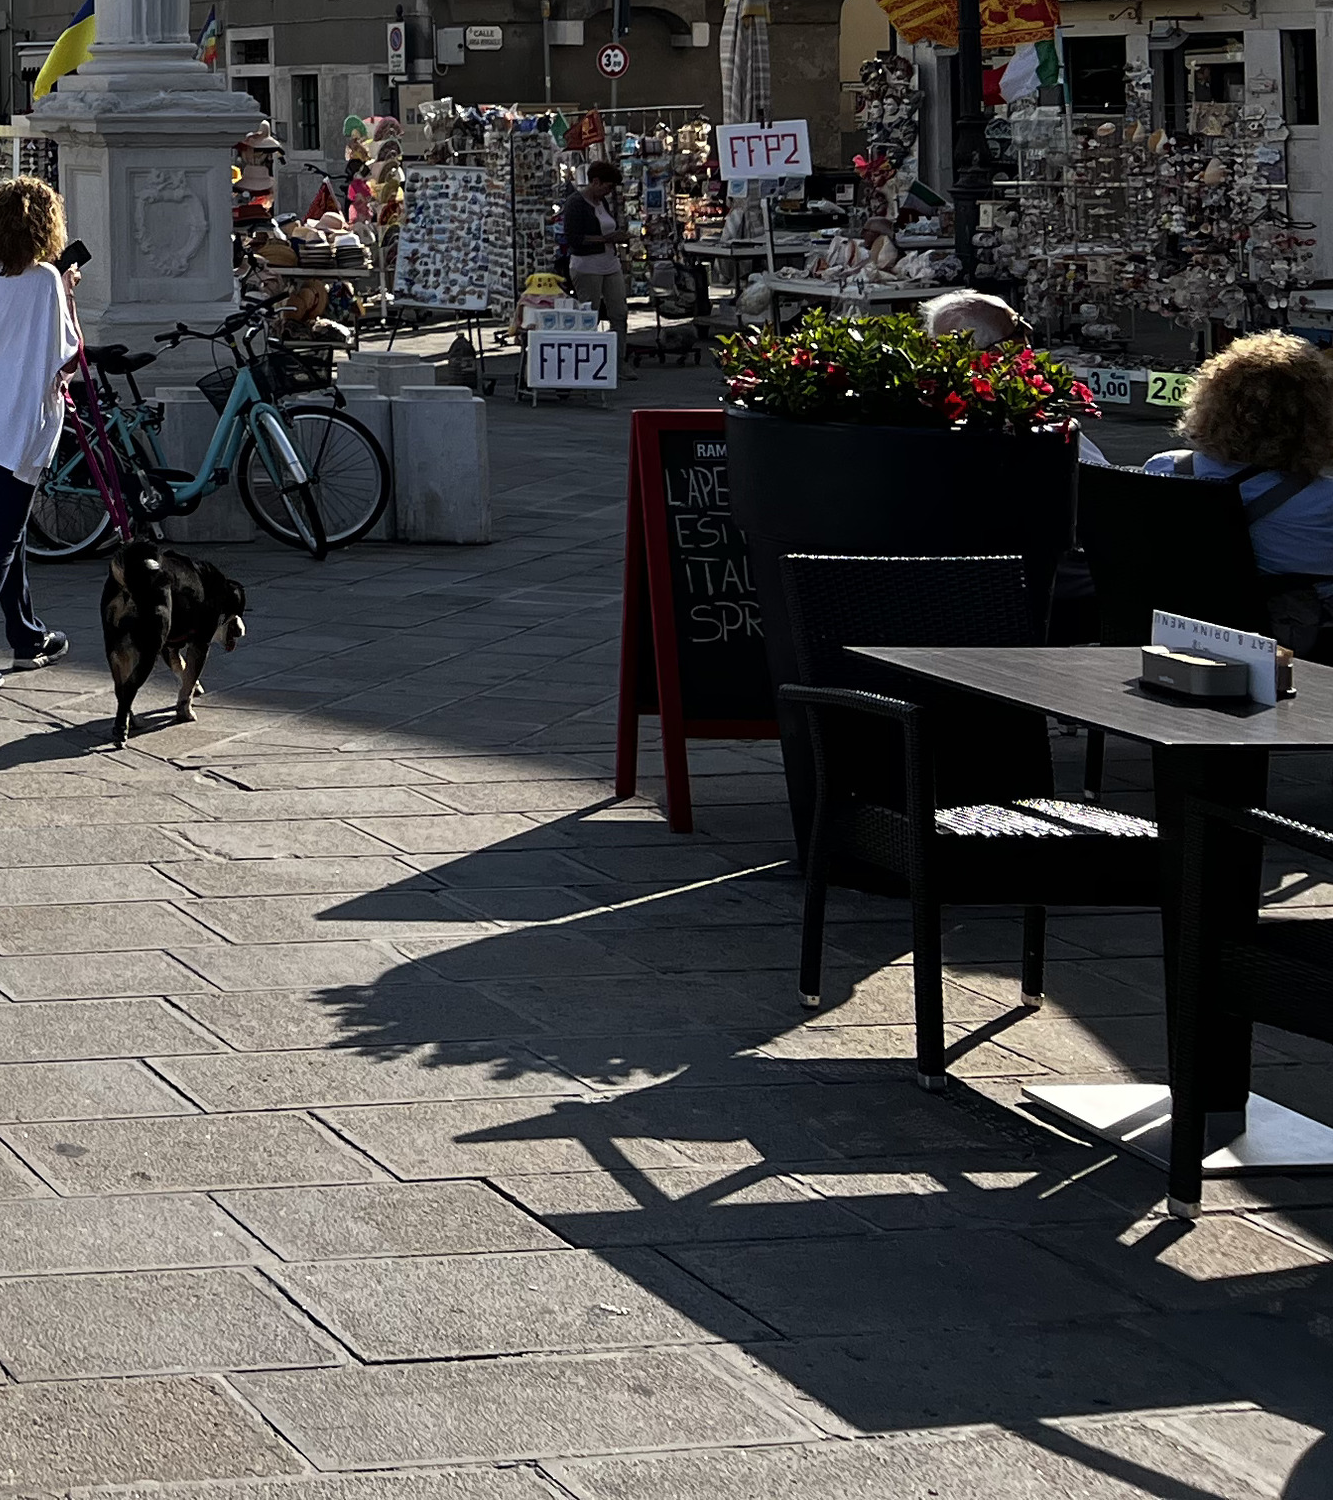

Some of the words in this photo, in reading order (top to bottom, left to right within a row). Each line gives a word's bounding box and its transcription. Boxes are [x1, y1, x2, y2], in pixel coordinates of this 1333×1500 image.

[473, 29, 495, 38] CALLE
[729, 133, 800, 168] FFP2
[540, 343, 607, 380] FFP2
[1091, 371, 1128, 398] 3,00
[1154, 612, 1186, 630] MENU
[1193, 623, 1230, 642] DRINK
[1237, 634, 1244, 646] &
[1251, 639, 1274, 654] EAT
